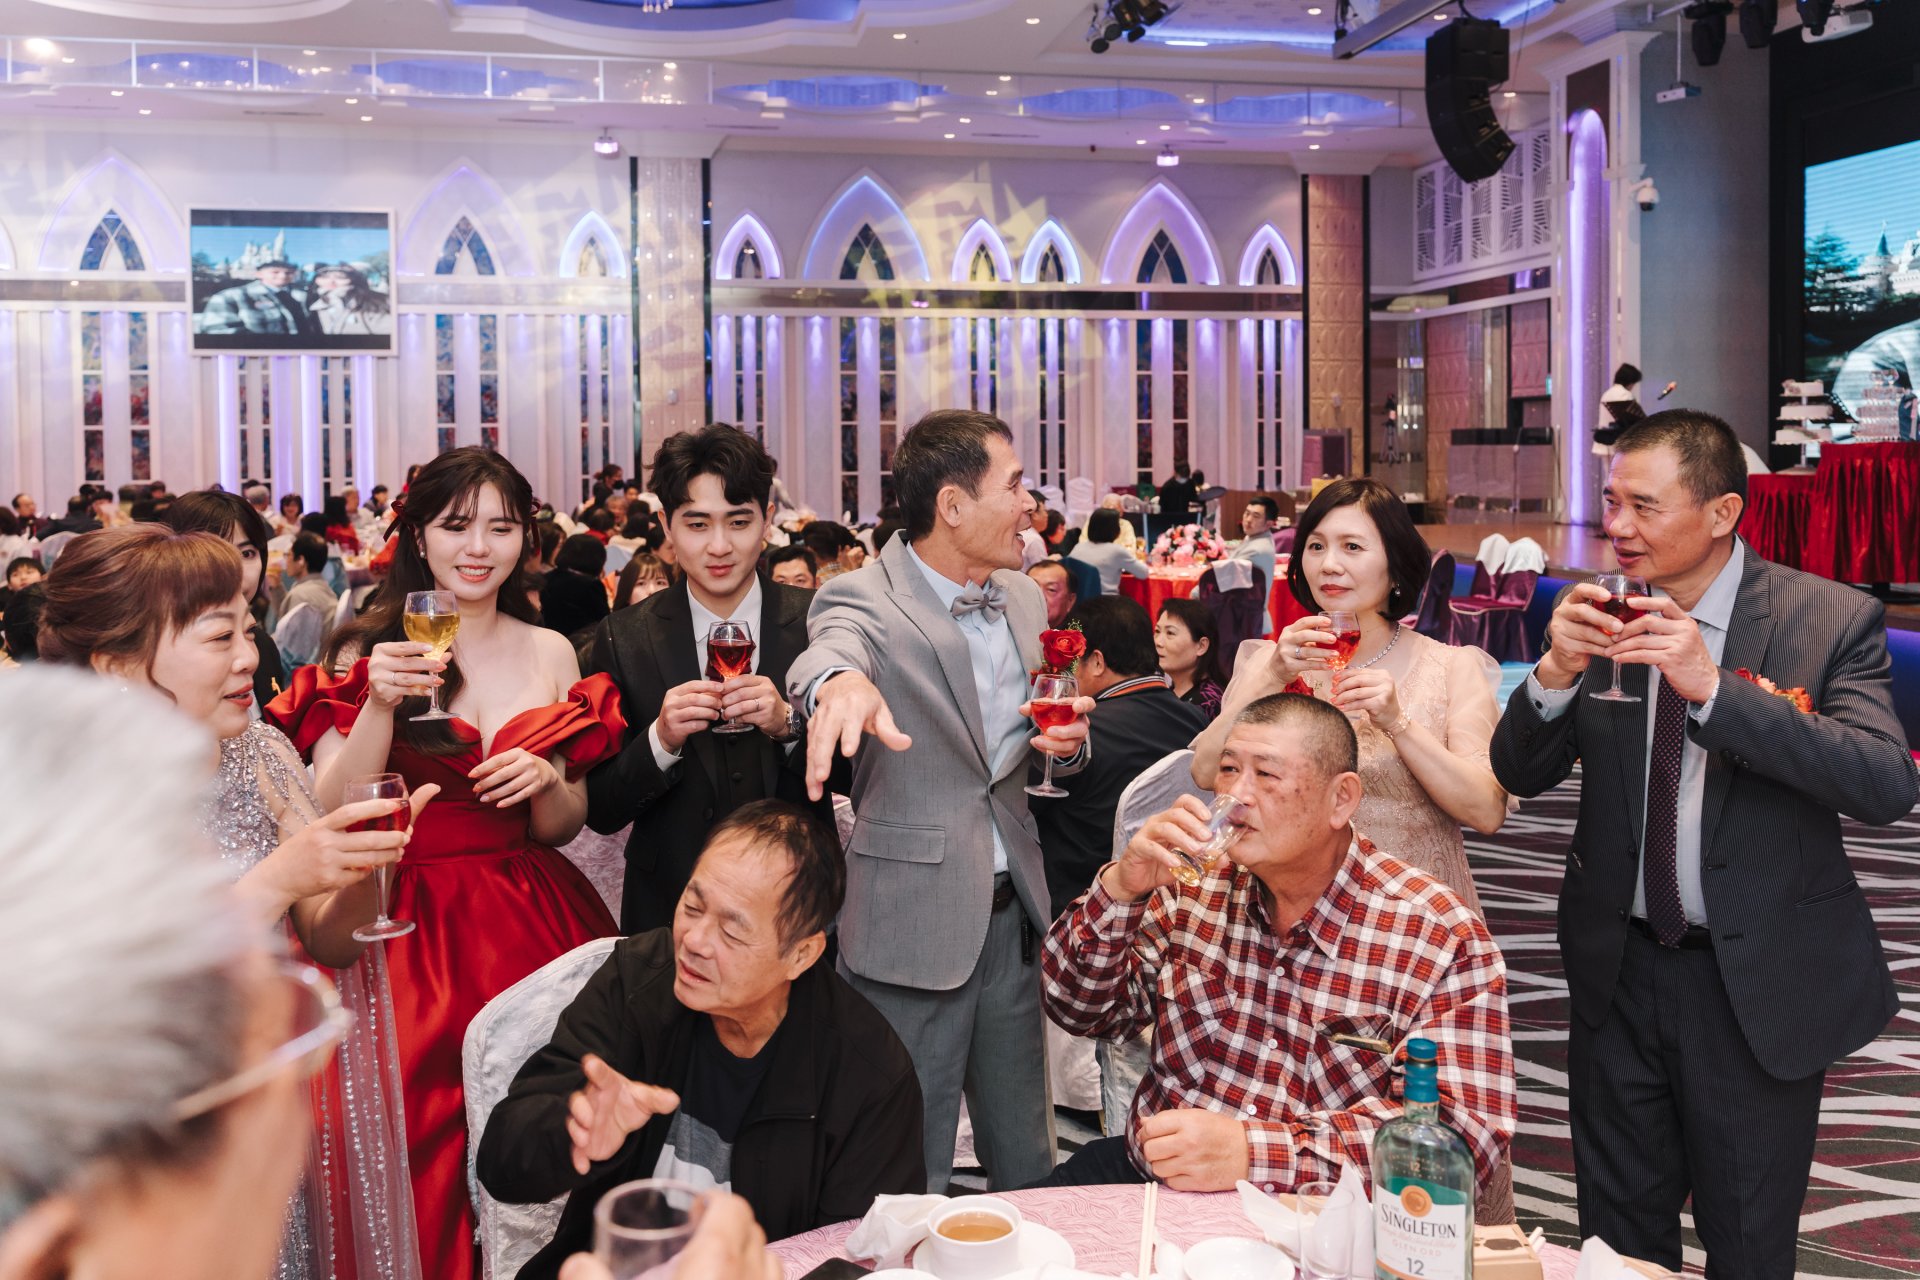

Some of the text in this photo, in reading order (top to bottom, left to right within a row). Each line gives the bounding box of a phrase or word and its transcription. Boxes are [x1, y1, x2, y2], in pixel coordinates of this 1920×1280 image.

[1381, 1203, 1457, 1239] SINGLETON
[1420, 1247, 1442, 1257] ORD
[1406, 1257, 1425, 1276] 12
